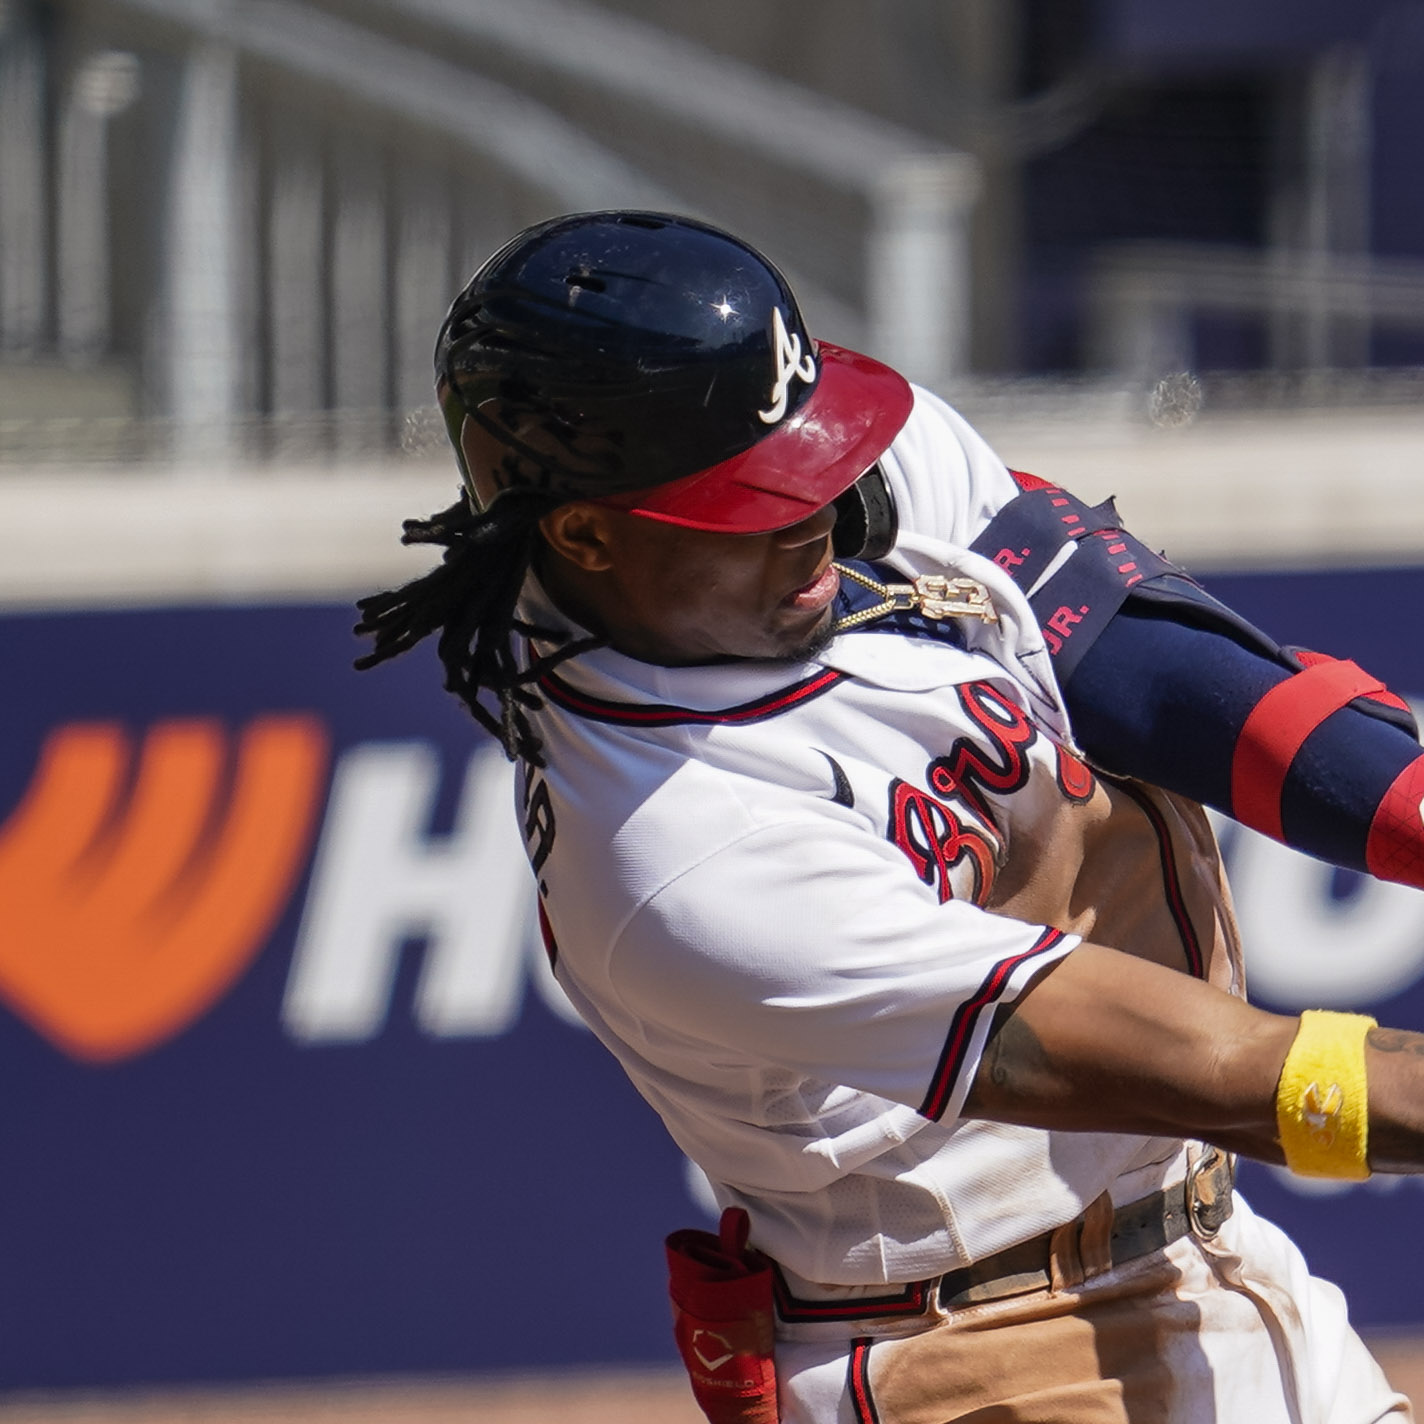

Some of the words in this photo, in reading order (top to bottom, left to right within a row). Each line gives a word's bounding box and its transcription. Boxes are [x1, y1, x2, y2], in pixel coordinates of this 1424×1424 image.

[757, 306, 816, 424] A
[993, 548, 1031, 576] R.
[1041, 605, 1089, 656] JR.
[887, 680, 1038, 906] Bra
